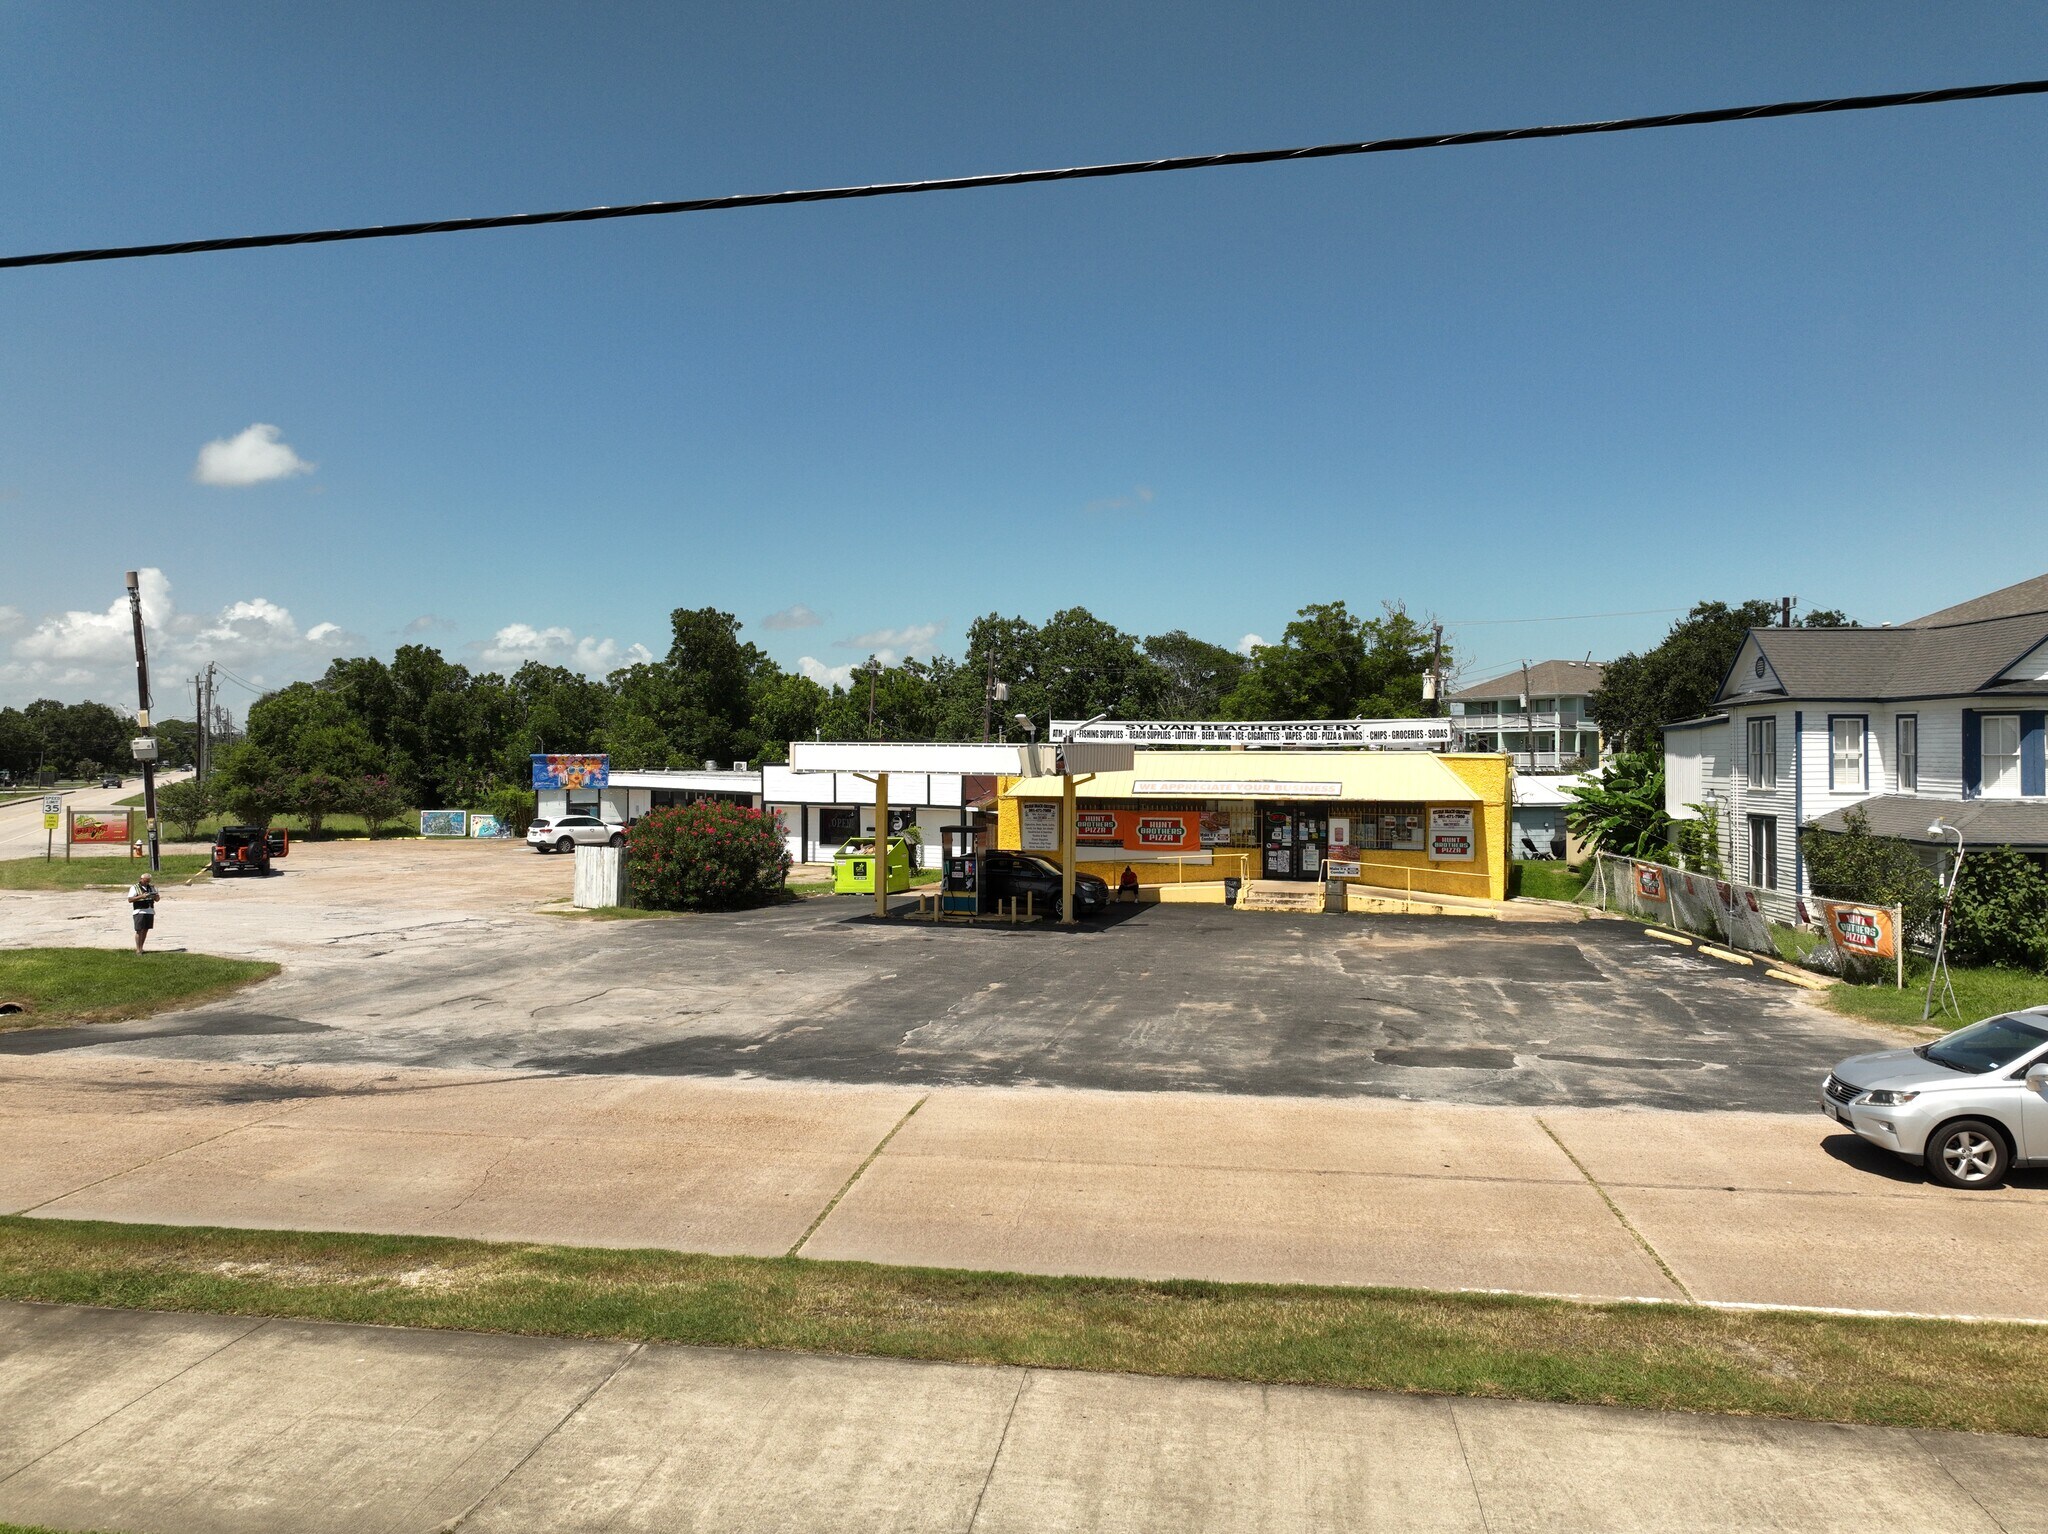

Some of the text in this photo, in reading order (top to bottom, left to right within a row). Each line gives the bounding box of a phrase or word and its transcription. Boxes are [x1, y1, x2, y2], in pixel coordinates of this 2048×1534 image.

[1100, 730, 1124, 739] SUPPLIES
[1129, 730, 1146, 740] BEACH
[1147, 731, 1171, 740] SUPPLIES
[1175, 731, 1197, 740] LOTTERY
[1201, 731, 1215, 740] BEER
[1218, 731, 1232, 740] WINE
[1235, 731, 1244, 741] ICE
[1247, 731, 1280, 741] CIGARETTES
[1284, 731, 1302, 741] VAPES
[1306, 731, 1318, 741] CBD
[1321, 731, 1337, 740] PIZZA
[1343, 731, 1363, 741] WINGS
[1369, 730, 1388, 740] CHIPS
[1391, 729, 1424, 740] GROCERIES
[1428, 728, 1448, 739] SODAS
[1139, 783, 1337, 793] WE APPRECIATE YOUR BUSINESS
[45, 804, 60, 812] 35
[1140, 827, 1182, 835] BROTHERS
[1149, 834, 1174, 842] PIZZA
[1845, 931, 1868, 945] PIZZA
